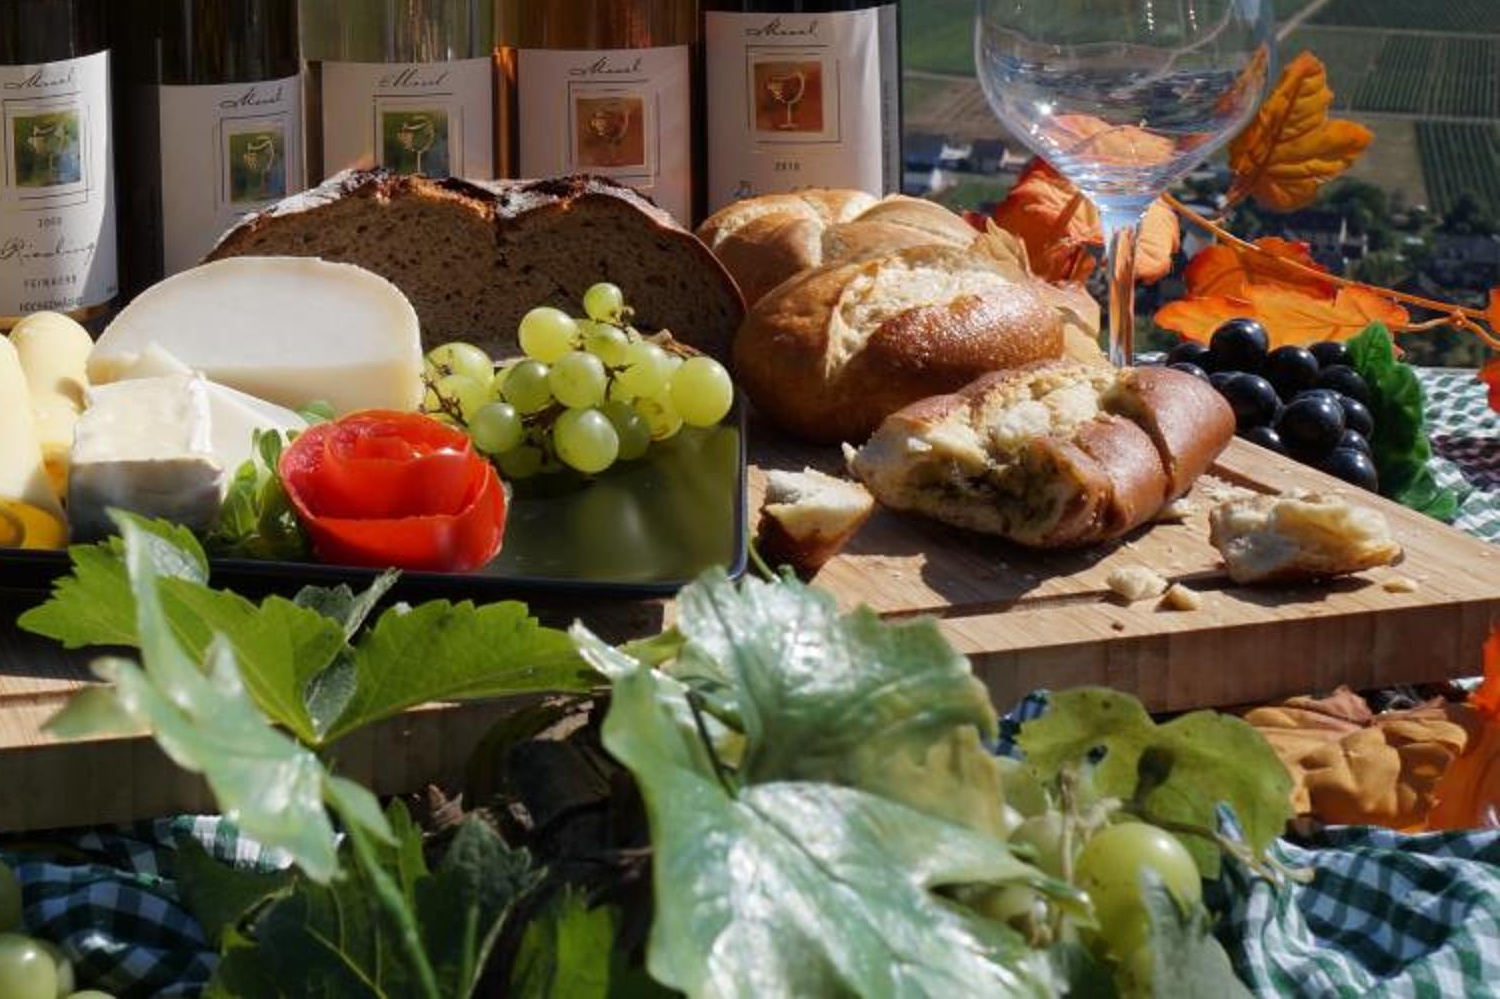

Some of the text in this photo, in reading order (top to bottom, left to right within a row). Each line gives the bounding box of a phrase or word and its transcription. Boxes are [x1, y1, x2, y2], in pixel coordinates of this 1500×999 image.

[746, 17, 818, 36] Mosel
[567, 56, 642, 76] Mosel
[3, 66, 76, 89] Mosel
[376, 68, 449, 88] Mosel
